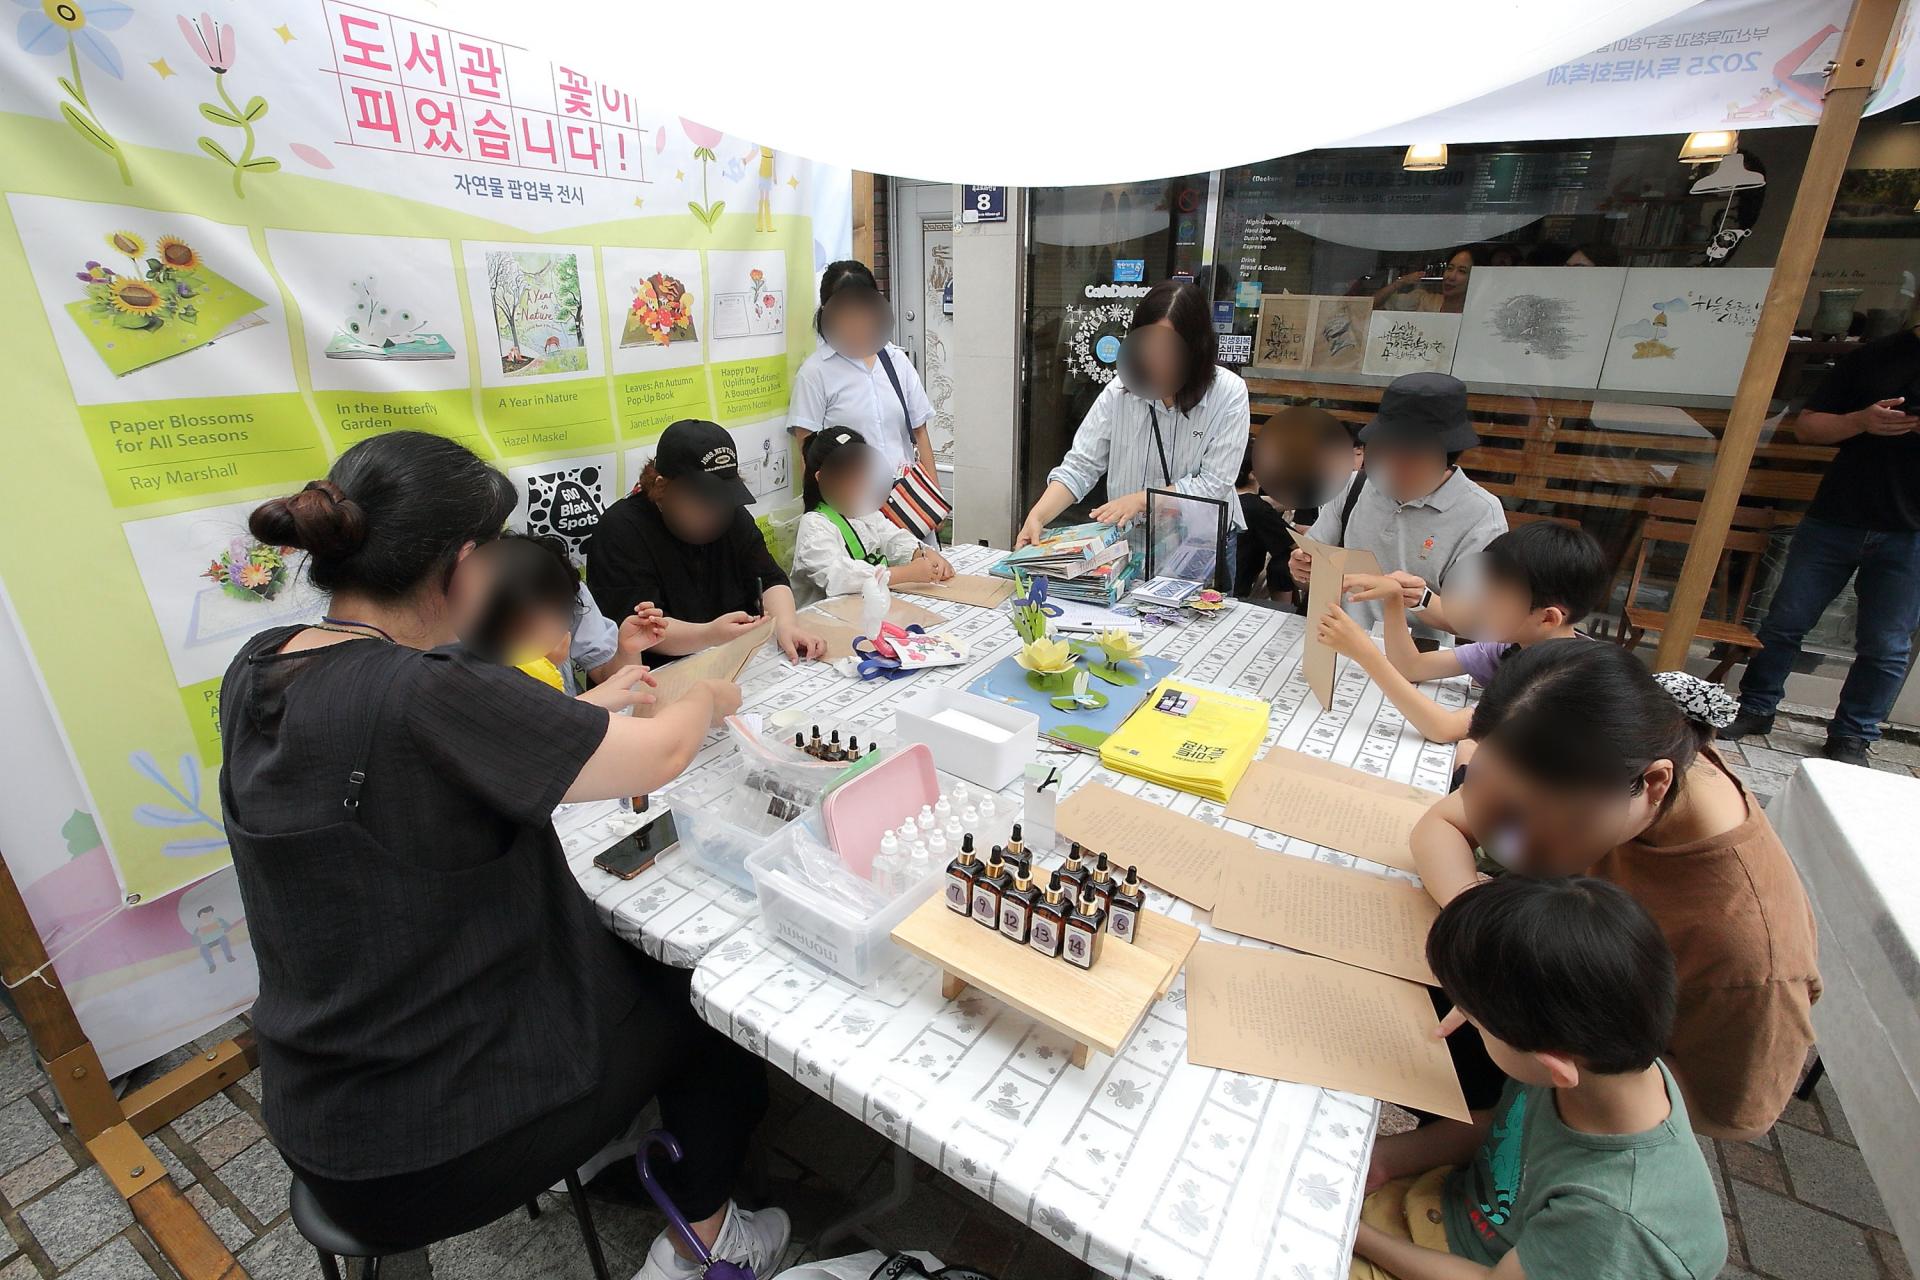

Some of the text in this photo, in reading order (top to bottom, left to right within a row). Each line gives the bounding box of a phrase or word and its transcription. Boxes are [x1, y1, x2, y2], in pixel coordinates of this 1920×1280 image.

[339, 13, 631, 123] 도서관 꽃이
[352, 86, 628, 171] 피었습니다!
[454, 174, 584, 205] 자연물 팝업북 전시
[977, 193, 991, 211] 8
[522, 309, 554, 321] Nature
[1218, 345, 1249, 353] 소비쿠폰
[720, 366, 759, 377] Happy Day
[625, 377, 694, 393] Leaves: An Autumn
[499, 393, 578, 408] A Year in Nature
[627, 389, 674, 406] Pop-Up Book
[725, 391, 731, 399] A
[731, 388, 760, 398] Bouquet
[337, 402, 438, 415] In the Butterfly
[109, 411, 255, 435] Paper Blossoms
[341, 417, 392, 430] Garden
[630, 419, 650, 429] Janet
[116, 430, 249, 453] for All Seasons
[503, 431, 568, 447] Hazel Maskel
[130, 462, 239, 490] Ray Marshall
[561, 488, 581, 501] 600
[560, 499, 593, 517] Black
[558, 513, 599, 530] Spots
[951, 885, 961, 899] 7
[979, 899, 987, 912] 9
[1004, 914, 1018, 928] 12
[1117, 917, 1126, 931] 6
[1034, 926, 1050, 943] 13
[1069, 938, 1084, 956] 14
